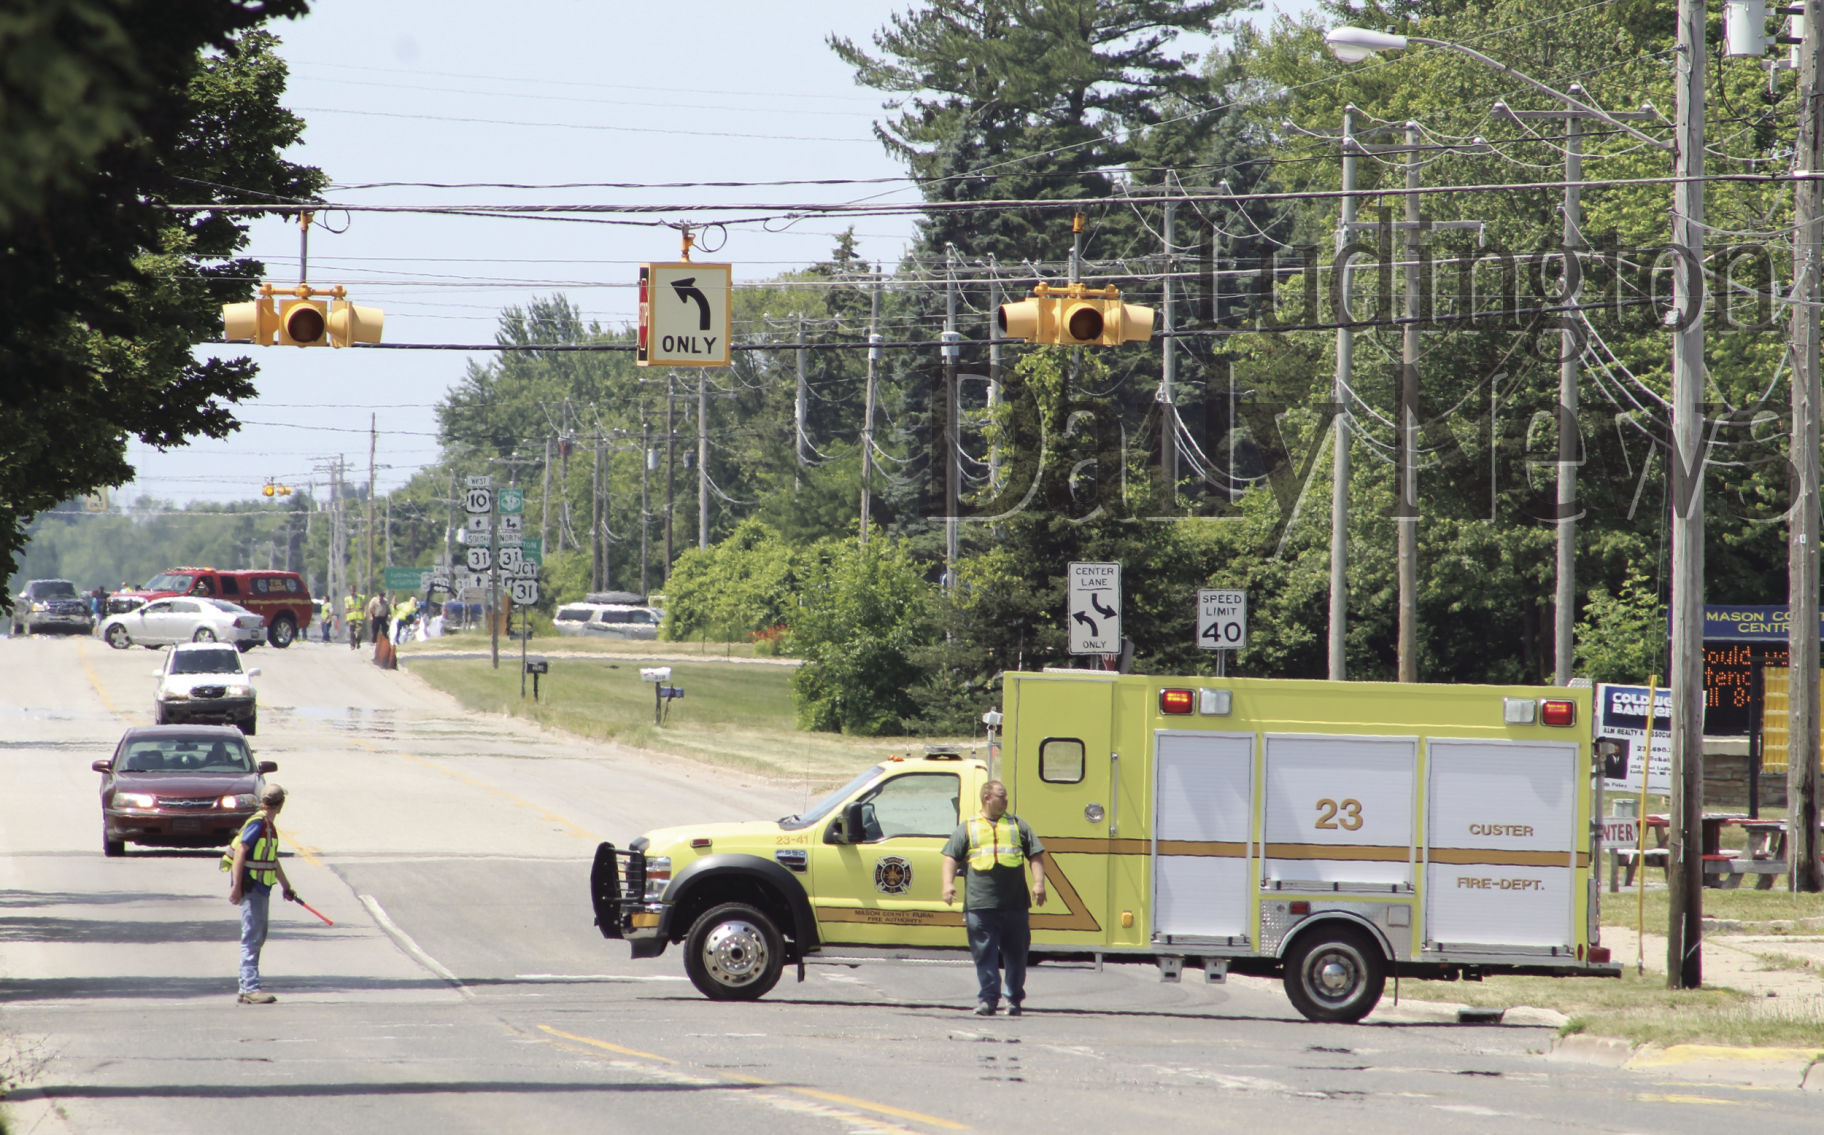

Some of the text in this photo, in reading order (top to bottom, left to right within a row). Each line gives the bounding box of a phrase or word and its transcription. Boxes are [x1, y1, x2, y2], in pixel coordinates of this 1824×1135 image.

[662, 335, 717, 354] ONLY
[471, 494, 487, 508] 10
[472, 552, 487, 565] 31
[503, 552, 519, 566] 31
[515, 563, 536, 576] JCT
[1075, 567, 1115, 576] CENTER
[1081, 578, 1108, 586] LANE
[516, 584, 533, 600] 31
[1202, 594, 1243, 604] SPEED
[1205, 607, 1237, 616] LIMIT
[1706, 611, 1764, 622] MASON
[1201, 621, 1242, 643] 40
[1082, 640, 1108, 649] ONLY
[1314, 798, 1364, 831] 23
[1469, 823, 1534, 837] CUSTER
[1602, 823, 1634, 841] NTER
[776, 834, 809, 846] 23-41
[1457, 877, 1545, 891] FIRE-DEPT.
